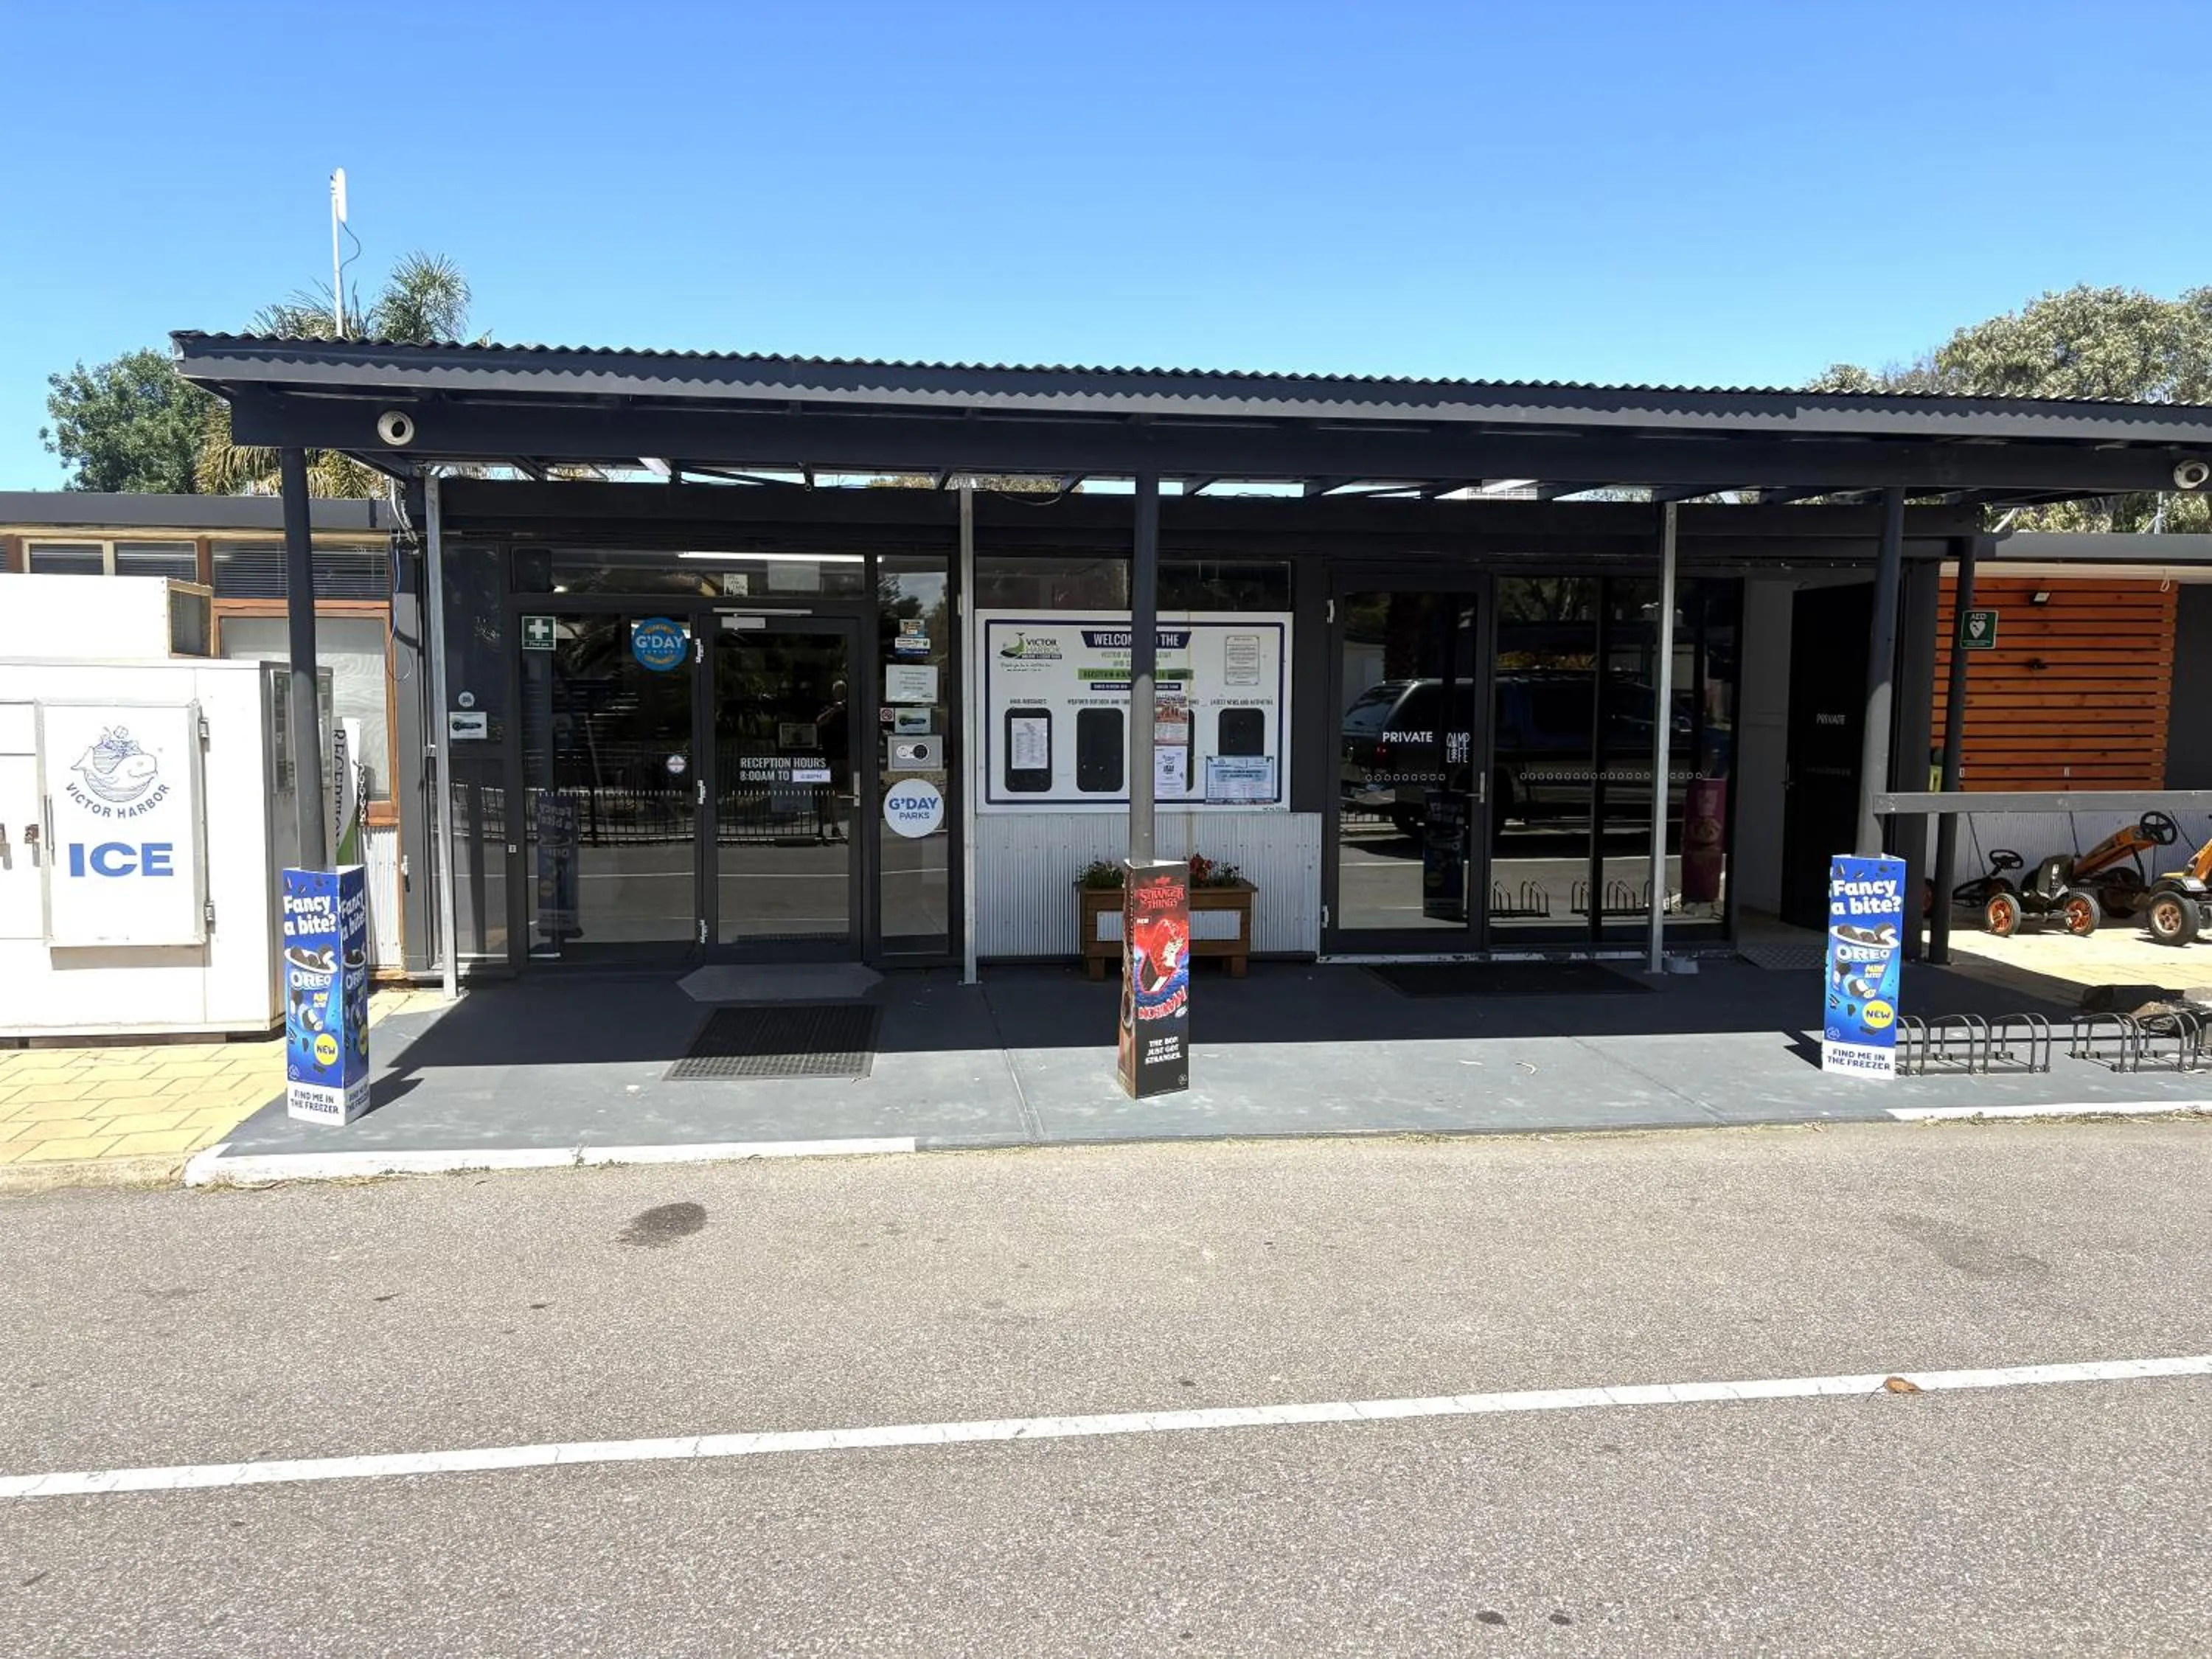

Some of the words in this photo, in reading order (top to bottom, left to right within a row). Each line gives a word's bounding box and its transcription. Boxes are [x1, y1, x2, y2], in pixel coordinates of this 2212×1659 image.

[636, 635, 684, 648] G'DAY
[1093, 633, 1132, 646] WELCOM
[1161, 634, 1180, 647] THE
[1382, 731, 1433, 742] PRIVATE
[740, 757, 791, 768] RECEPTION
[793, 757, 827, 768] HOURS
[740, 771, 775, 781] 8:00AM
[778, 771, 790, 781] TO
[65, 782, 112, 818] VICTOR
[116, 784, 170, 818] HARBOR
[888, 797, 939, 810] G'DAY
[899, 812, 931, 821] PARKS
[69, 841, 174, 878] ICE
[1832, 880, 1897, 897] Fancy
[283, 895, 331, 915] Fancy
[1831, 902, 1846, 915] a
[1849, 896, 1902, 914] bite?
[284, 921, 295, 936] a
[297, 913, 337, 935] bite?
[1836, 945, 1891, 962] OREO
[290, 970, 332, 989] OREO
[1865, 1009, 1891, 1019] NEW
[316, 1044, 336, 1055] NEW
[1149, 1038, 1163, 1048] THE
[1147, 1047, 1164, 1057] JUST
[1164, 1044, 1180, 1053] GOT
[1832, 1048, 1856, 1058] FIND
[1857, 1051, 1872, 1060] ME
[1874, 1053, 1885, 1061] IN
[1827, 1055, 1846, 1065] THE
[1847, 1059, 1891, 1070] FREEZER
[294, 1089, 311, 1099] FIND
[312, 1092, 324, 1102] ME
[325, 1094, 334, 1104] IN
[290, 1098, 305, 1109] THE
